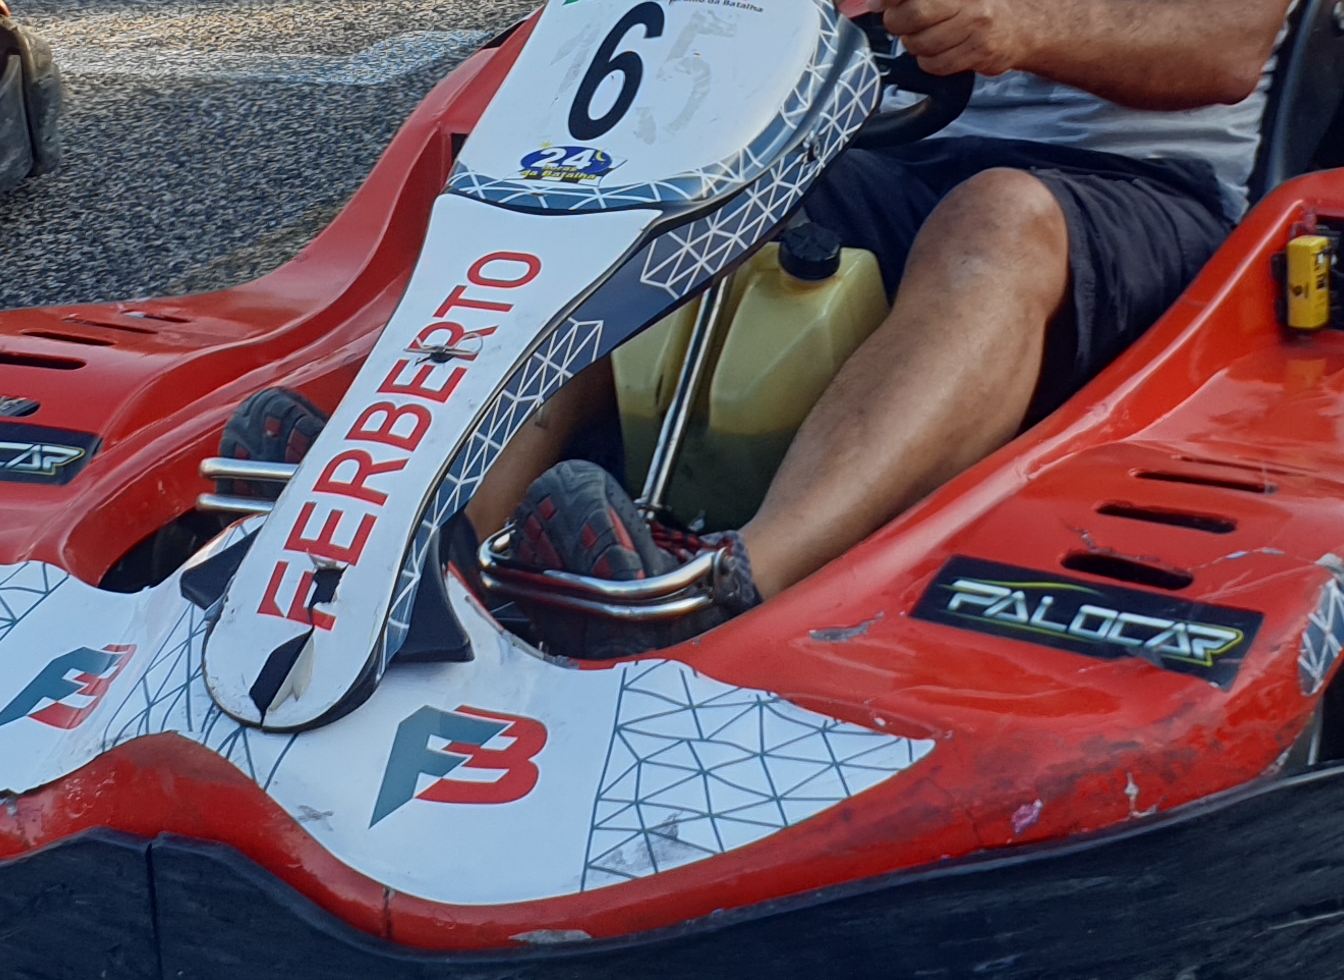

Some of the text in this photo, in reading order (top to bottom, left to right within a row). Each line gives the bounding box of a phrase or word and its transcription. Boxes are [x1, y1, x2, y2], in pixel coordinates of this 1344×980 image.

[567, 1, 666, 141] 6
[530, 147, 596, 169] 24
[256, 250, 542, 632] FERBERTO
[946, 578, 1240, 663] PALOCAR
